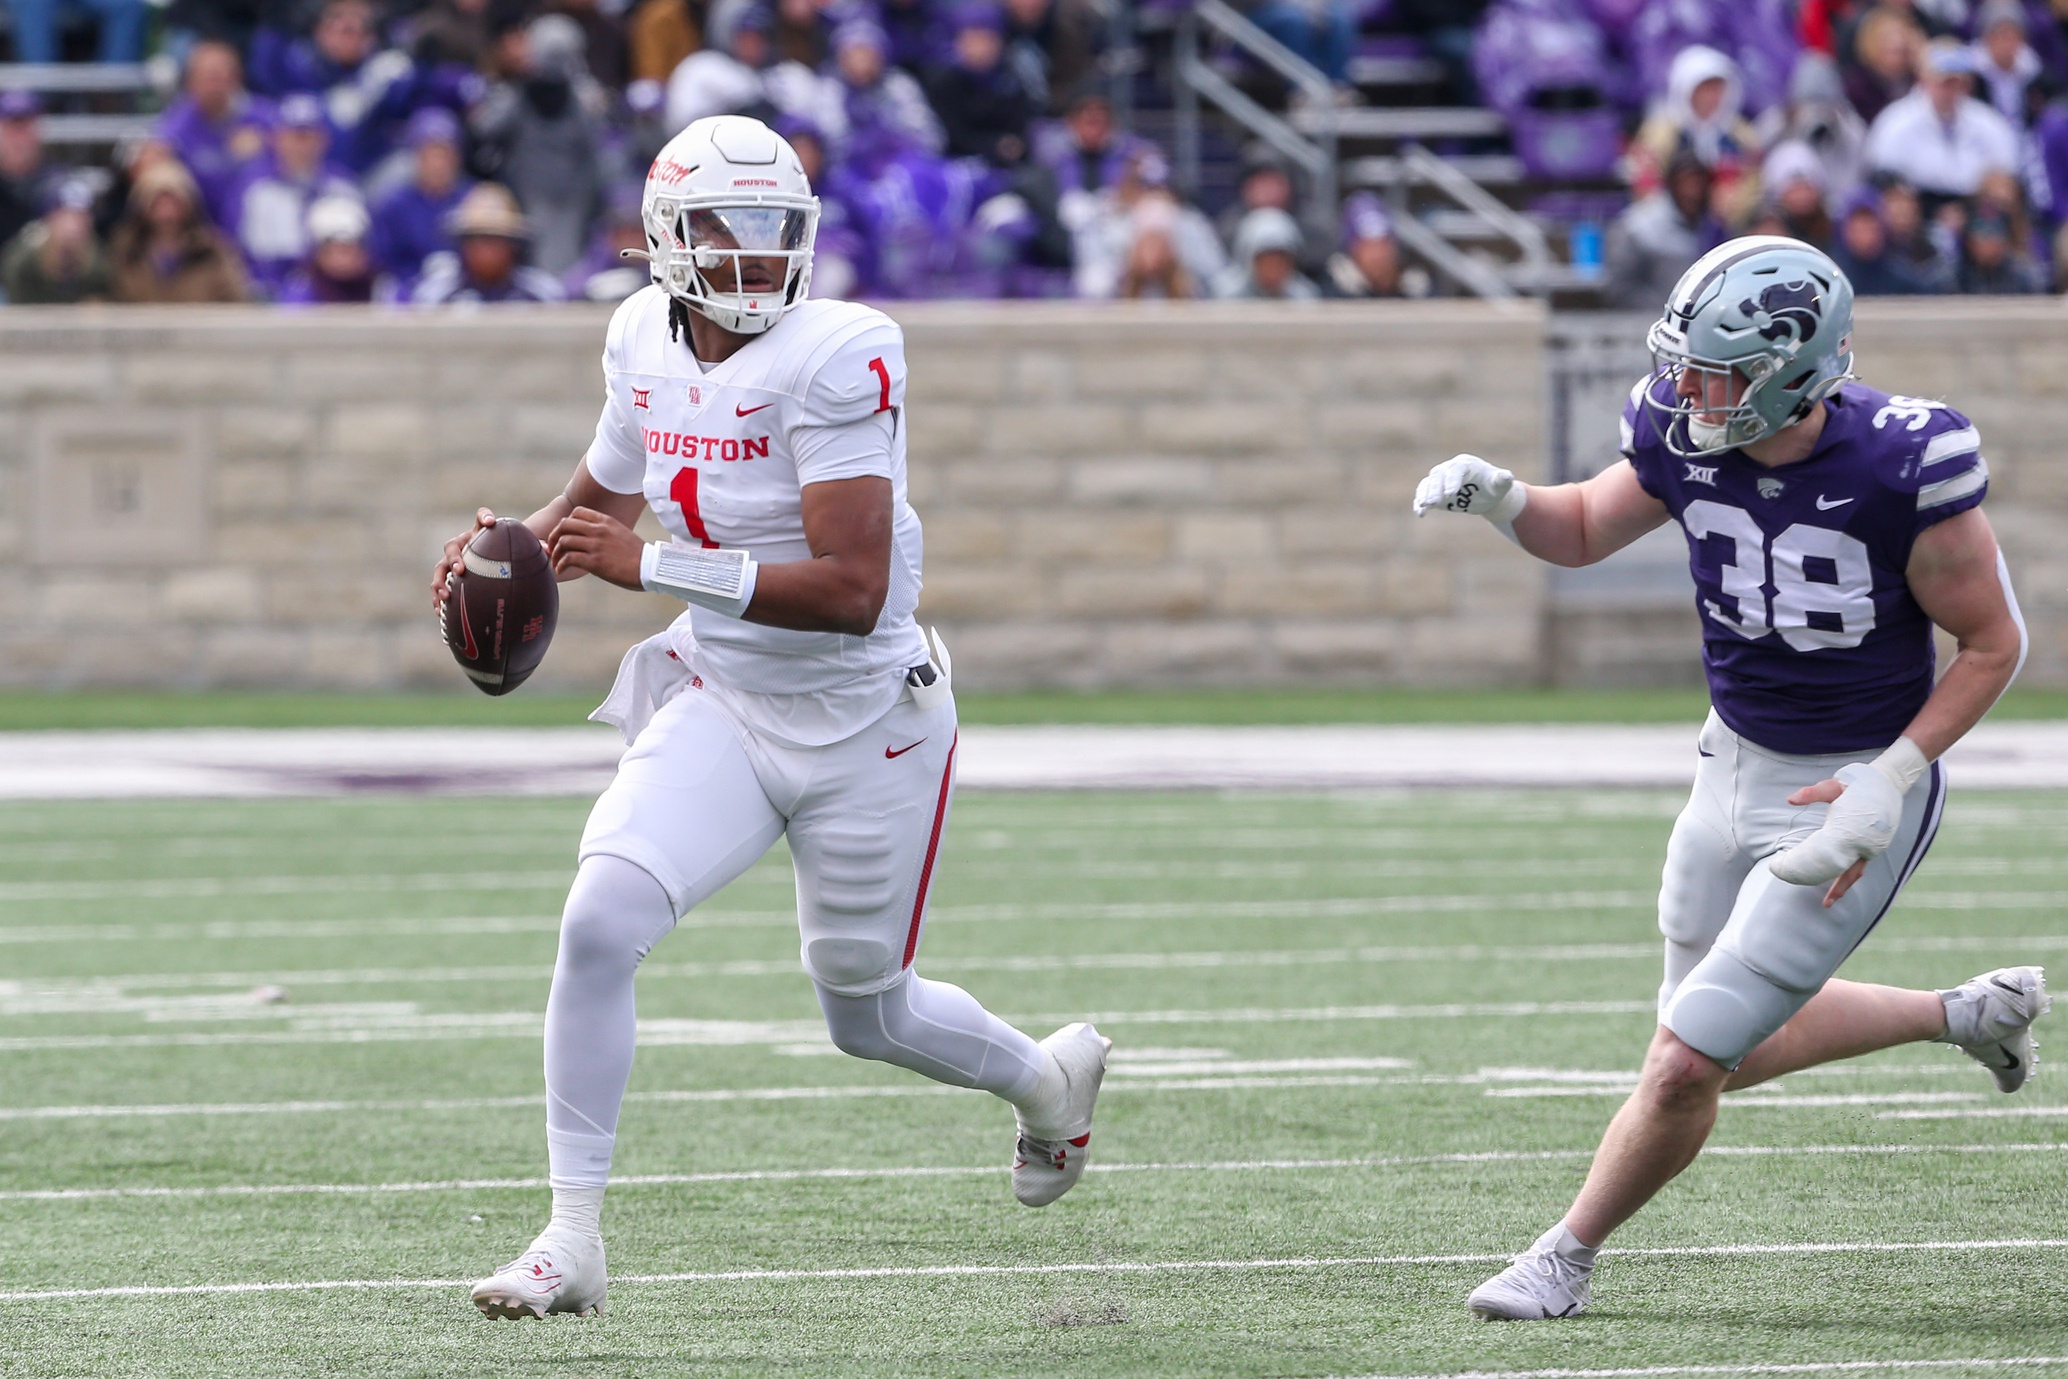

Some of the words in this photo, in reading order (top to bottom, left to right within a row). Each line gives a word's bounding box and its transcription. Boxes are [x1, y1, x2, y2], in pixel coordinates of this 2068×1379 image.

[733, 179, 777, 187] HOUSTON
[868, 356, 893, 414] 1
[1683, 462, 1719, 487] XII
[670, 466, 720, 549] 1
[1682, 498, 1877, 653] 38
